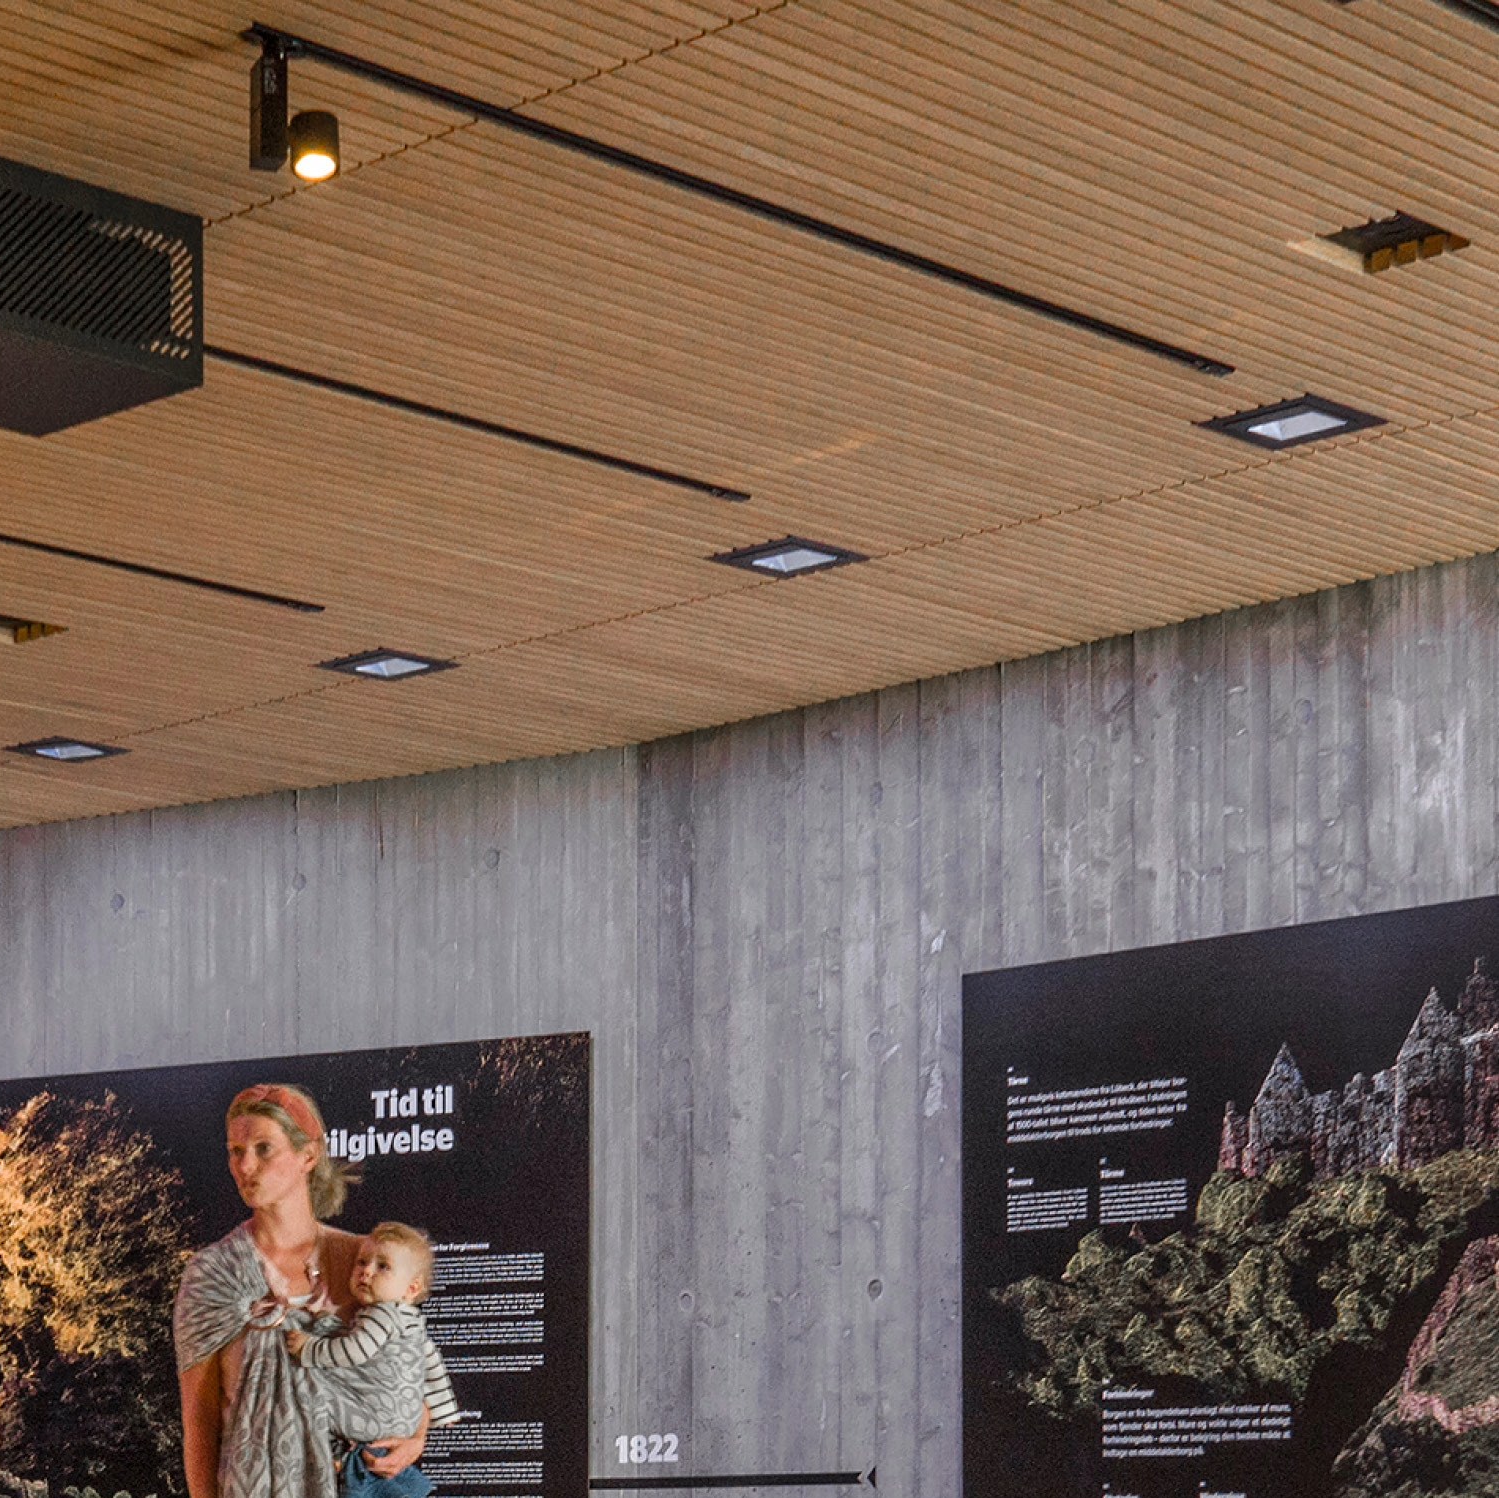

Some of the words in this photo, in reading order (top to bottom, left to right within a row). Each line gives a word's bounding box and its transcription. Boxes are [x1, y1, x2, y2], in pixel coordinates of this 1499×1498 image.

[370, 1087, 418, 1119] Tid
[422, 1084, 454, 1116] til
[615, 1433, 679, 1464] 1822
